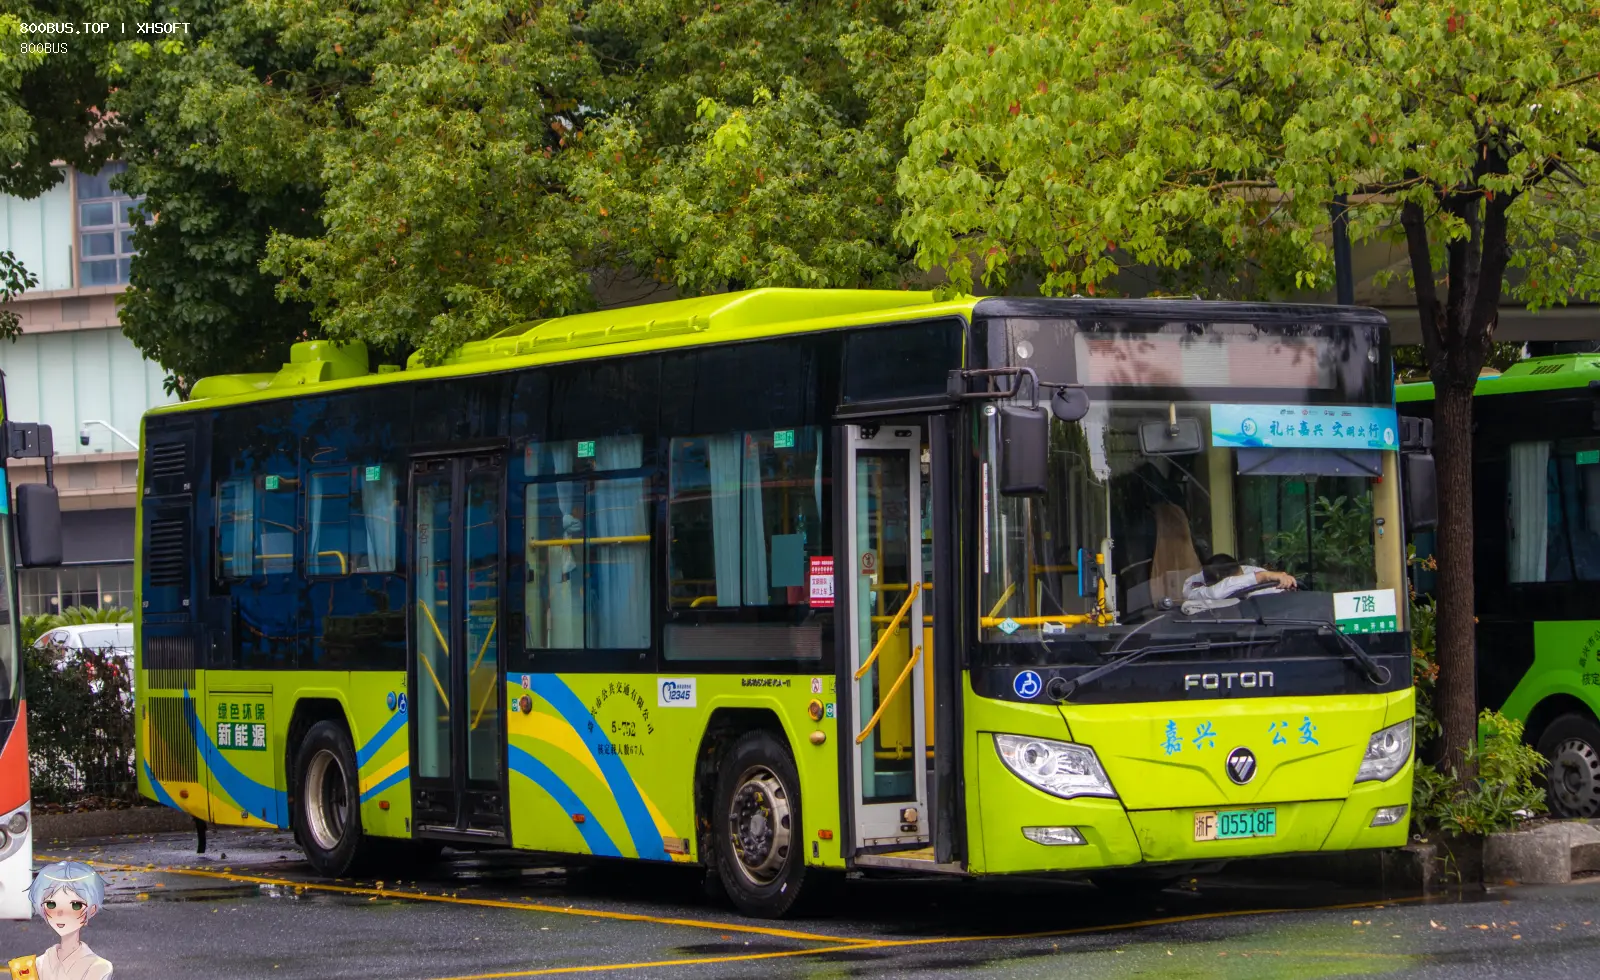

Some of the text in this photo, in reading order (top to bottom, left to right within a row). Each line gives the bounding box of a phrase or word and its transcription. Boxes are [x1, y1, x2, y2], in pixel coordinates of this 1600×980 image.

[1269, 420, 1324, 437] 礼行嘉兴
[1332, 421, 1379, 438] 文明出行
[1353, 595, 1376, 613] 7路
[1184, 671, 1274, 690] FOTON
[669, 690, 691, 700] 12345
[218, 703, 265, 720] 绿色环保
[218, 723, 265, 747] 新能源
[1160, 716, 1319, 756] 嘉兴 公交
